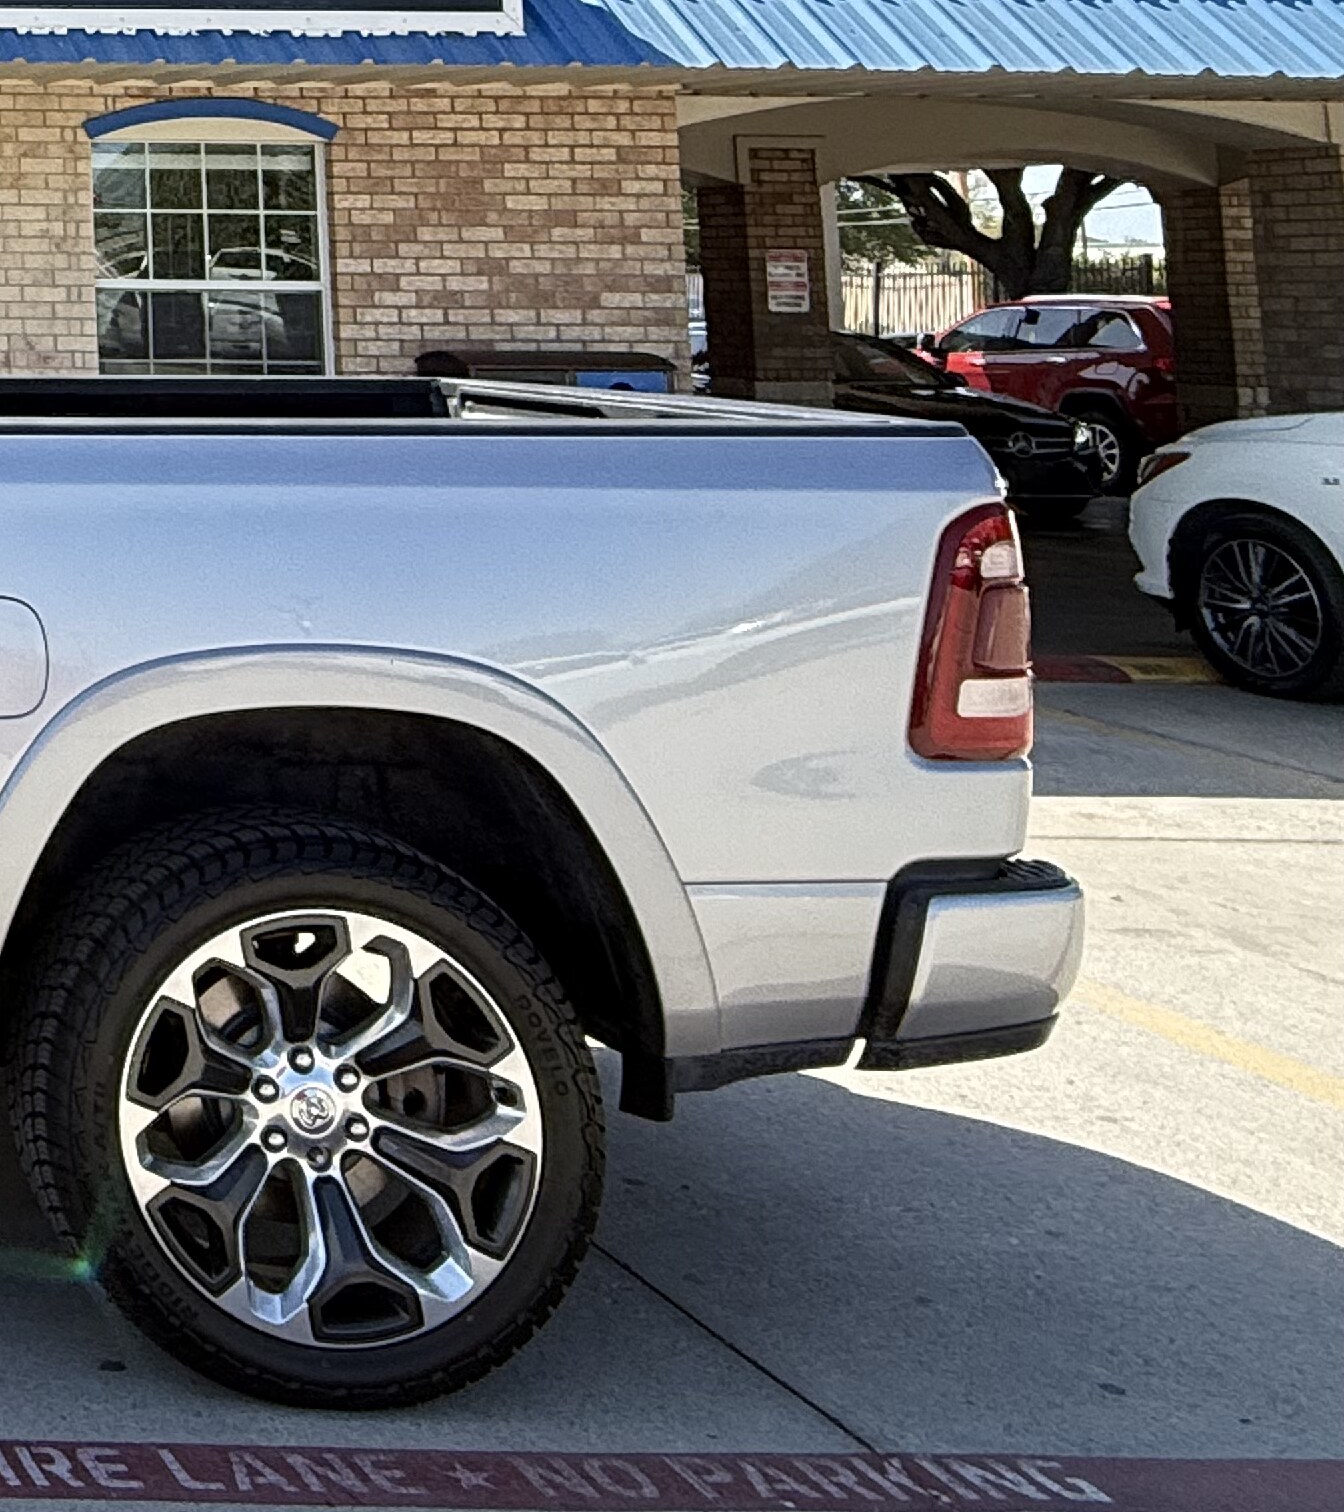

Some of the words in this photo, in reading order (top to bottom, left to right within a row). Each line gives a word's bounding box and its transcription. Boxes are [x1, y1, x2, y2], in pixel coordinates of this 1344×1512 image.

[157, 1448, 429, 1495] LANE
[512, 1455, 660, 1499] NO
[663, 1455, 1112, 1503] PARKING
